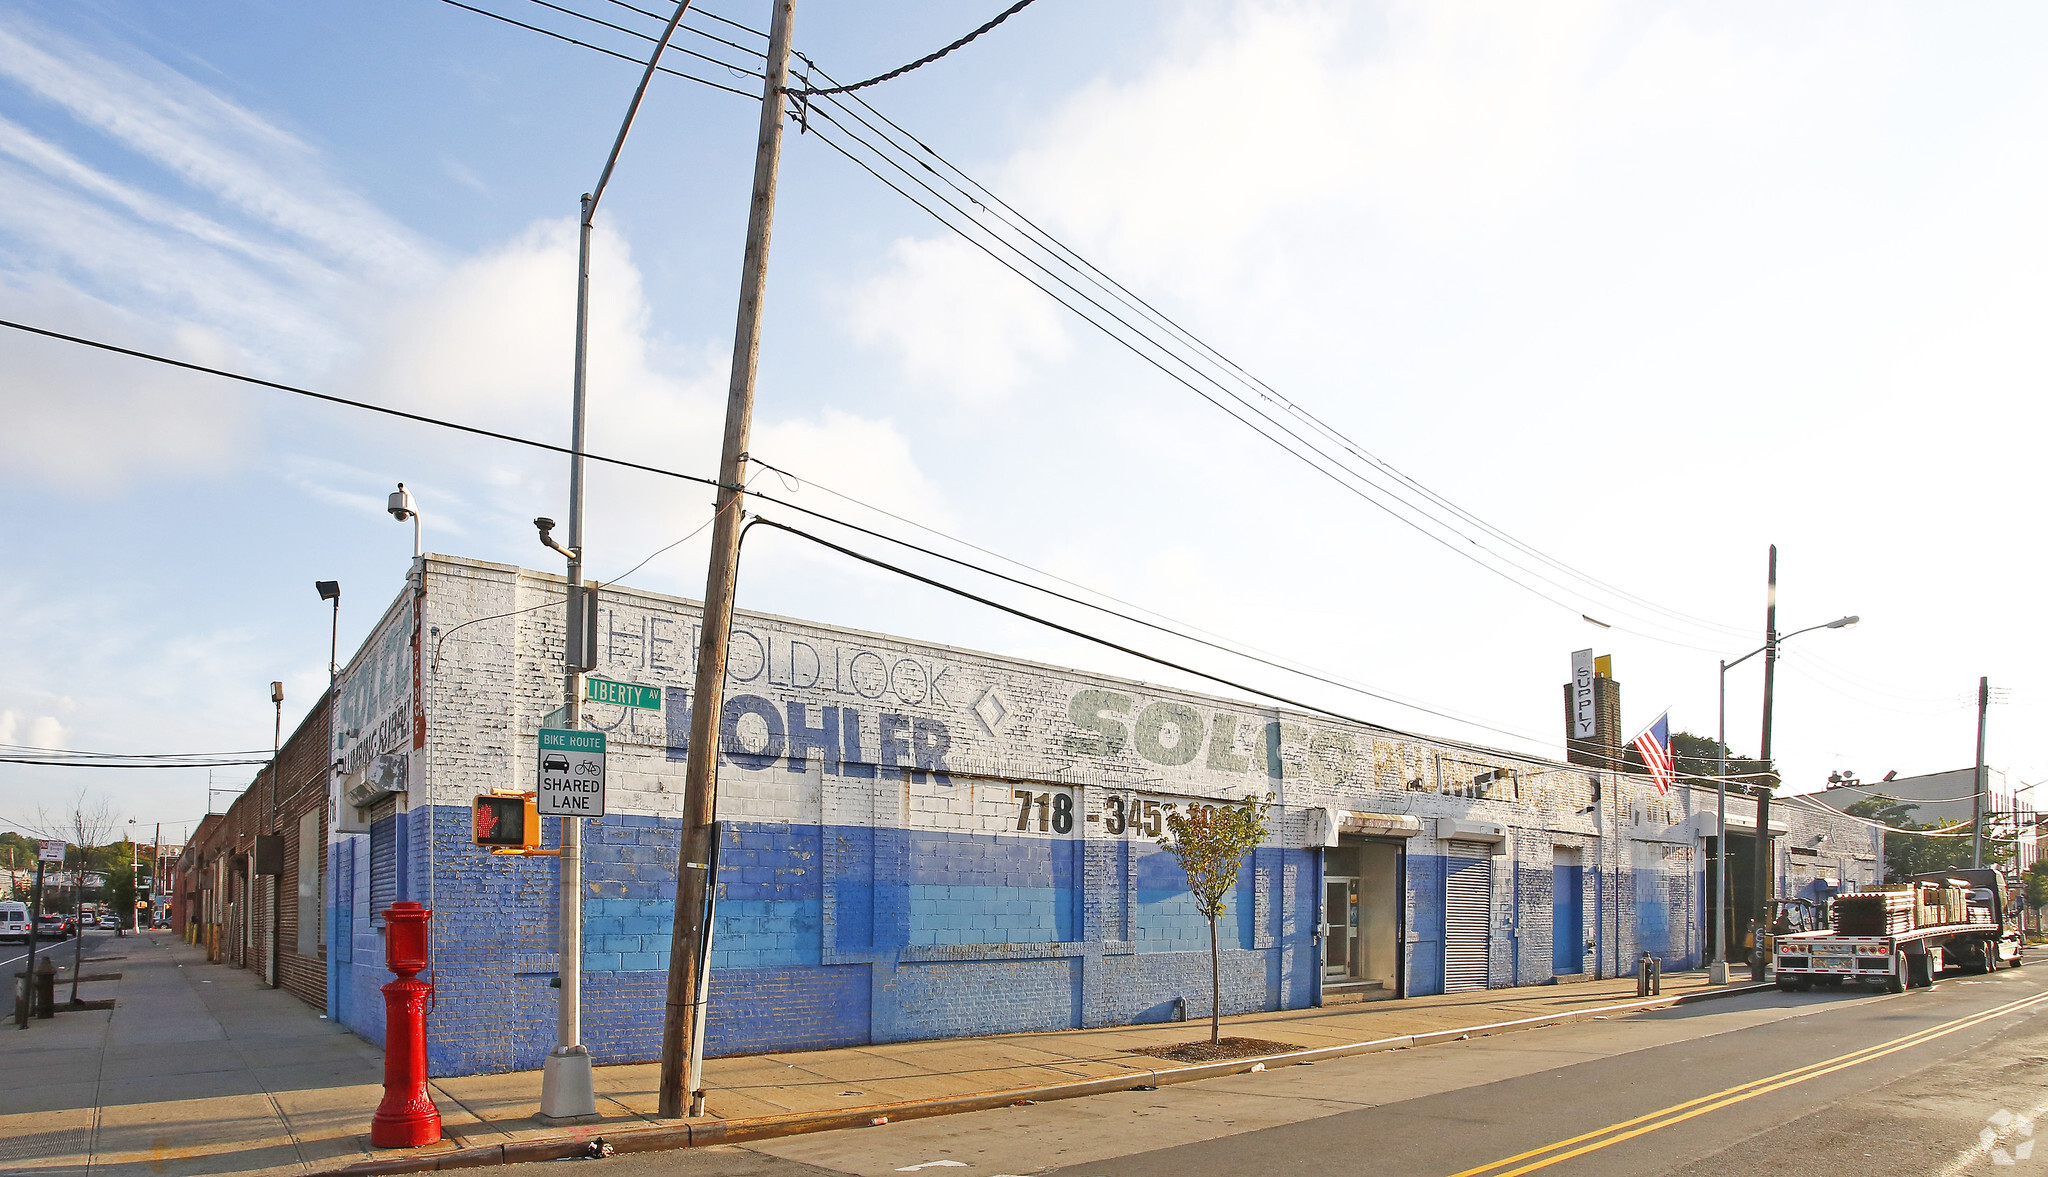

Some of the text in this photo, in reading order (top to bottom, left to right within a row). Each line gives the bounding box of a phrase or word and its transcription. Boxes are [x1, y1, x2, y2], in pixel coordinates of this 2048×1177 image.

[599, 608, 674, 672] HE
[836, 647, 955, 709] LOOK
[587, 679, 660, 705] LIBERTY AV
[1577, 666, 1592, 732] SUPPLY
[544, 734, 601, 748] BIKE ROUTE
[543, 777, 600, 792] SHARED
[552, 795, 590, 809] LANE
